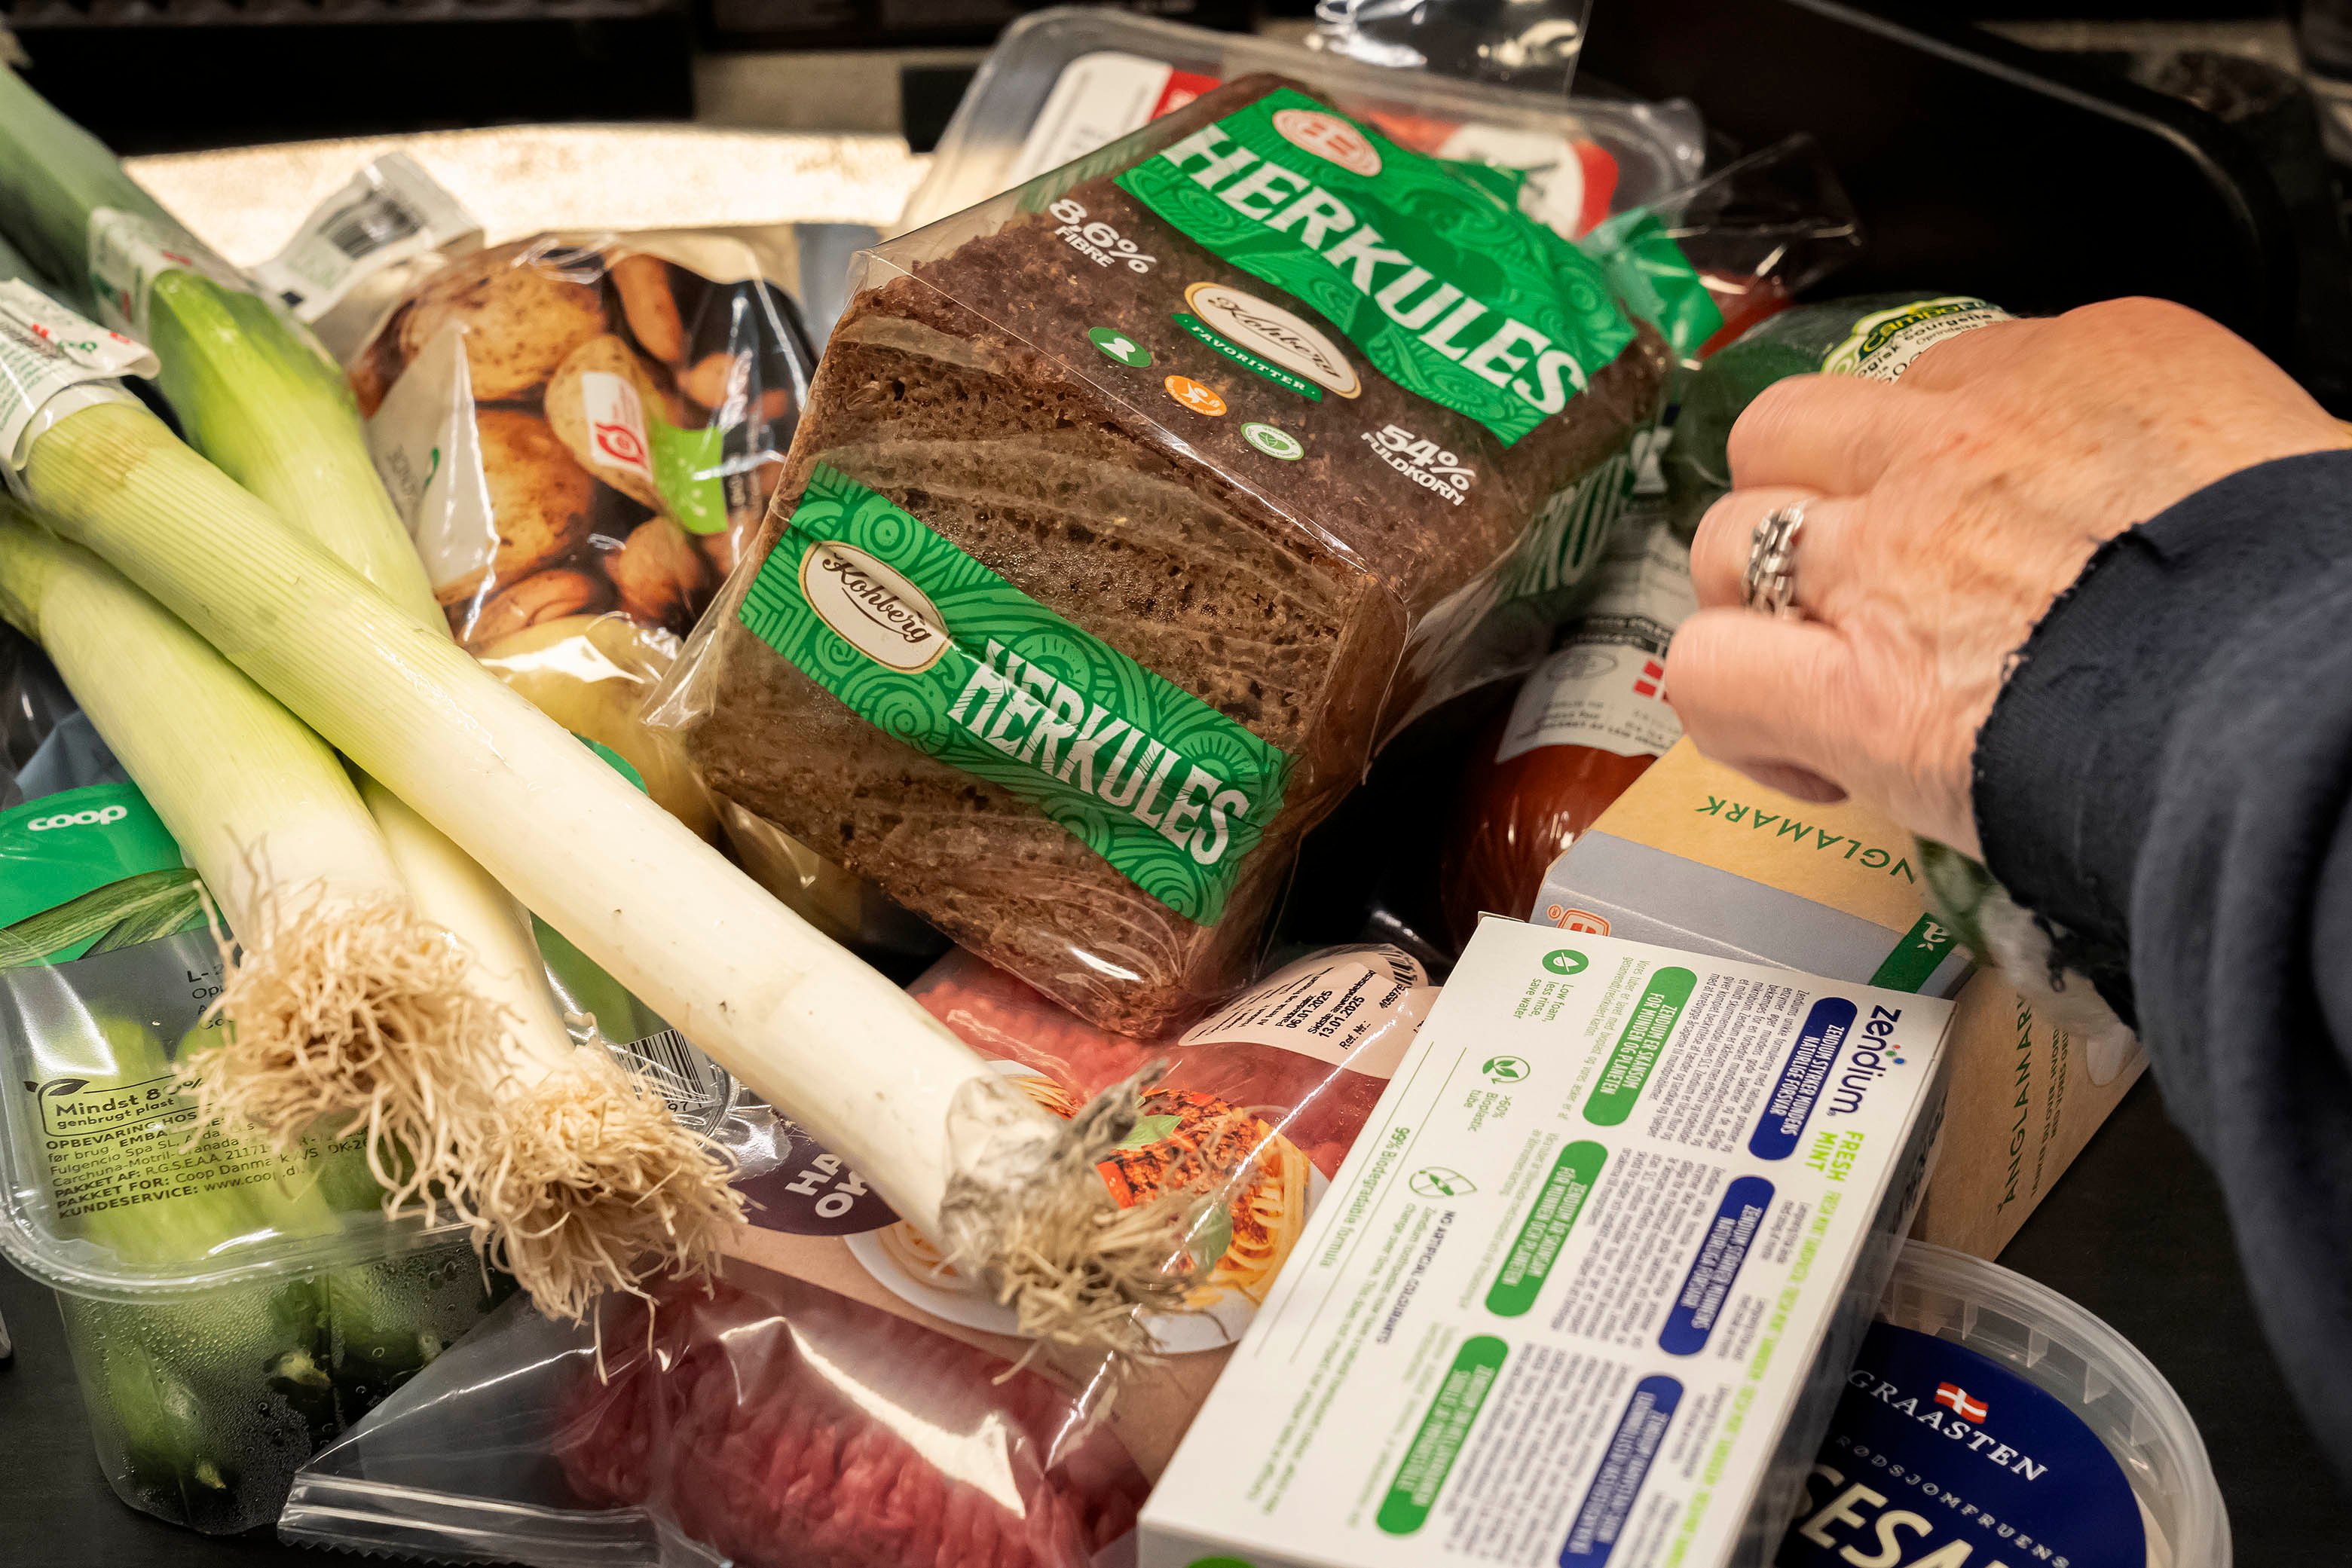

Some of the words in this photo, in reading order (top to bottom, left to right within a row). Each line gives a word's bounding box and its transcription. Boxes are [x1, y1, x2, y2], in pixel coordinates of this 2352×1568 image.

[1049, 199, 1157, 274] 8,6%
[1055, 225, 1115, 267] FIBRE
[1160, 123, 1589, 414] HERKULES
[1207, 297, 1342, 379] Kohberg
[1191, 326, 1306, 390] FAVORITTER
[1360, 432, 1465, 506] FULDKORN
[1375, 423, 1476, 491] 54%
[822, 552, 931, 644] Kohberg
[946, 637, 1251, 866] HERKULES
[26, 803, 127, 832] coop
[1695, 795, 1915, 884] NGLAMARK
[1632, 959, 1650, 975] Vores
[1705, 973, 1722, 986] med
[1716, 975, 1736, 991] giver
[1308, 1013, 1332, 1035] Sidste
[1332, 969, 1376, 1013] anvendelsesd
[1524, 977, 1541, 995] save
[1540, 980, 1558, 996] less
[1555, 983, 1574, 999] Low
[1642, 992, 1665, 1009] FOR
[1753, 983, 1779, 1014] bekæmpes
[1769, 986, 1791, 1010] enzymer
[1286, 990, 1333, 1029] 06.01.2025
[1319, 996, 1365, 1038] 13.01.2025
[1512, 996, 1532, 1019] water
[1527, 996, 1550, 1018] rinse,
[1540, 1000, 1564, 1023] foam,
[1625, 1007, 1657, 1041] MUNDEN
[1646, 1004, 1678, 1039] ZENDIUM
[1751, 1015, 1765, 1024] for
[1762, 1013, 1782, 1027] øger
[1729, 1012, 1751, 1037] Zendium
[1746, 1025, 1757, 1033] en
[1813, 1024, 1846, 1059] ZENDIUM
[1339, 1034, 1358, 1050] Ref.
[1619, 1041, 1640, 1054] OG
[1640, 1038, 1659, 1050] ER
[1785, 1035, 1821, 1079] NATURLIGE
[1598, 1053, 1633, 1095] PLANETEN
[1620, 1050, 1656, 1089] SKÅNSOM
[1833, 1005, 1903, 1114] zendium
[1753, 1072, 1769, 1086] med
[1797, 1059, 1829, 1095] STYRKER
[56, 1094, 139, 1116] Mindst
[57, 1110, 131, 1129] genbrugt
[136, 1098, 174, 1117] plast
[1462, 1089, 1482, 1108] tube
[1464, 1091, 1498, 1132] Bioplastic
[1491, 1095, 1514, 1119] >60%
[1767, 1077, 1801, 1116] FORSVAR
[46, 1121, 161, 1150] OPBEVARING
[162, 1111, 197, 1127] HOS
[1778, 1094, 1813, 1136] MUNDENS
[48, 1153, 69, 1163] før
[75, 1146, 113, 1160] brug.
[1384, 1126, 1412, 1150] 99%
[1803, 1130, 1838, 1171] MINT
[50, 1154, 121, 1175] Fulgencio
[126, 1145, 152, 1160] Spa
[53, 1137, 239, 1187] Carchuna-Motril-anada
[1824, 1129, 1865, 1182] FRESH
[55, 1176, 113, 1198] PAKKET
[118, 1170, 141, 1182] AF:
[57, 1186, 122, 1209] PAKKET
[130, 1177, 170, 1191] FOR:
[176, 1169, 214, 1184] Coop
[220, 1154, 290, 1174] Danmak
[1339, 1149, 1397, 1224] Biodegradable
[59, 1185, 199, 1218] KUNDESERVICE:
[1318, 1225, 1356, 1268] formula
[1847, 1369, 2048, 1482] GRAASTEN
